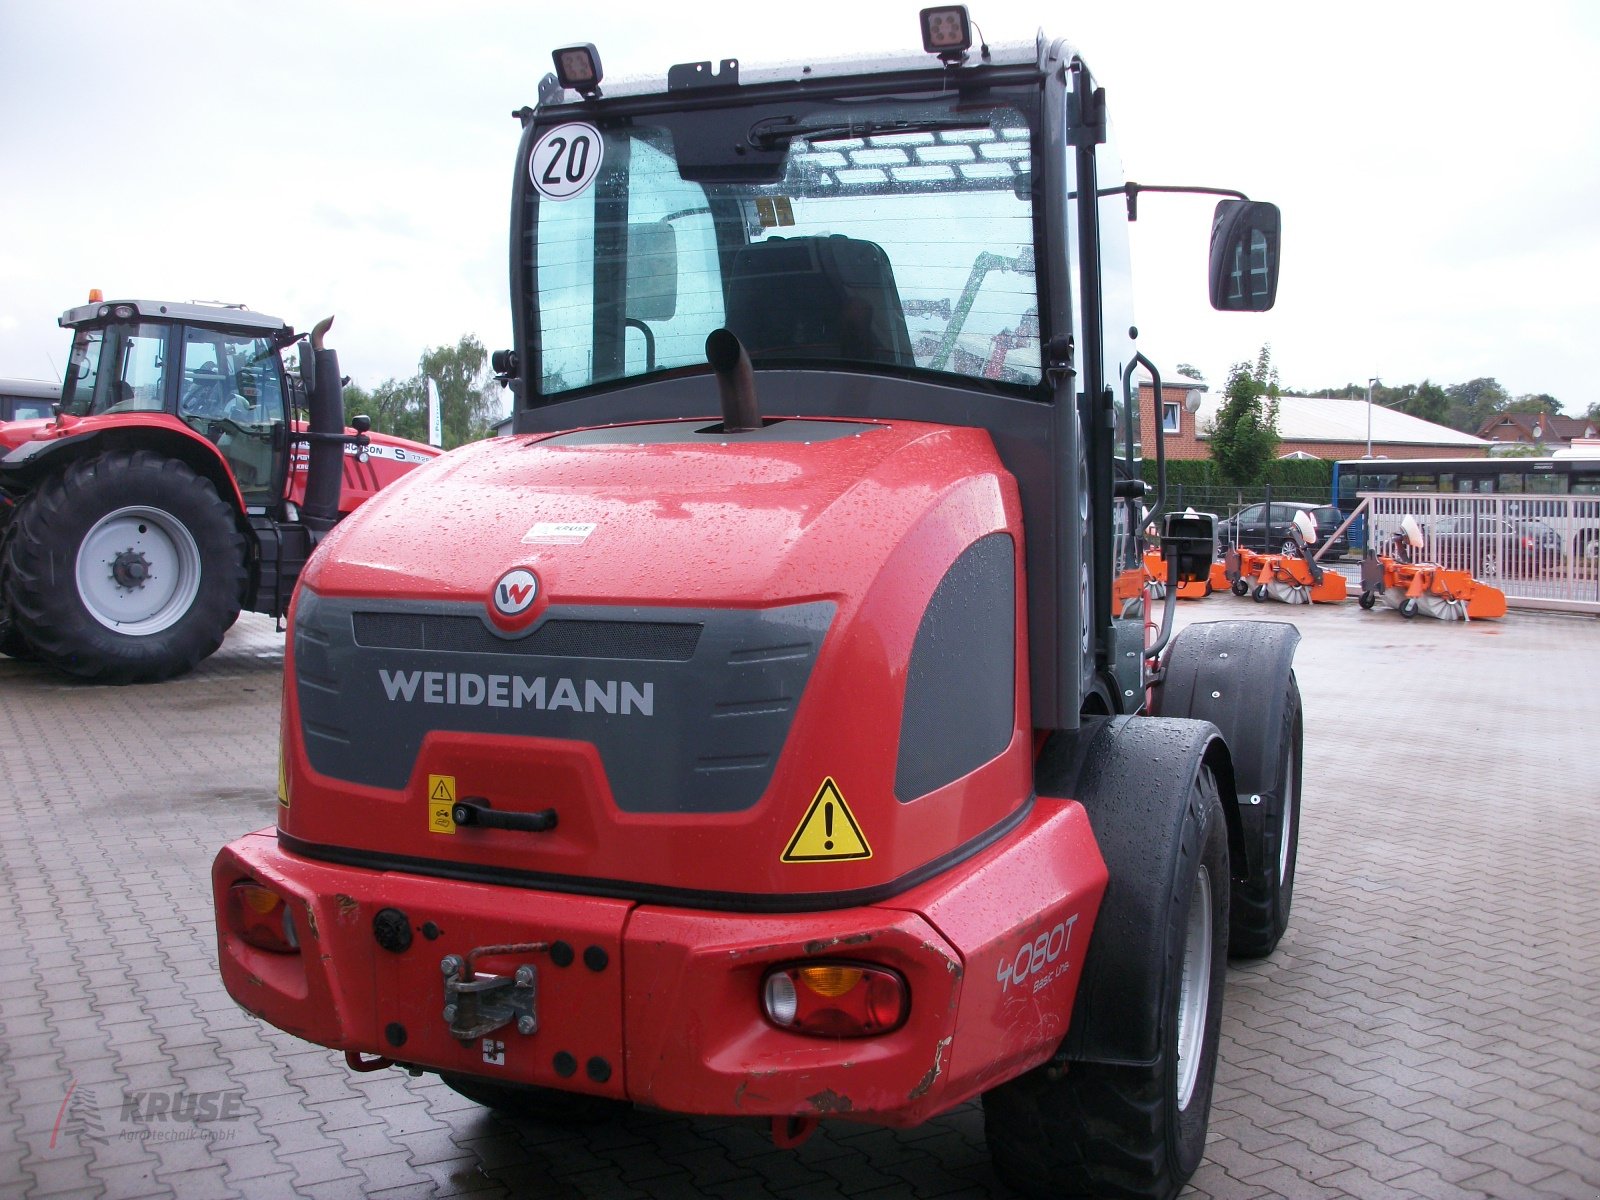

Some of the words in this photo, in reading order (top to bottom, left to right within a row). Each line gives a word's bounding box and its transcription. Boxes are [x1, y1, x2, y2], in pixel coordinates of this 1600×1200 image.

[542, 135, 590, 184] 20
[394, 449, 406, 460] S
[379, 669, 654, 716] WEIDEMANN
[997, 913, 1079, 993] 4080T
